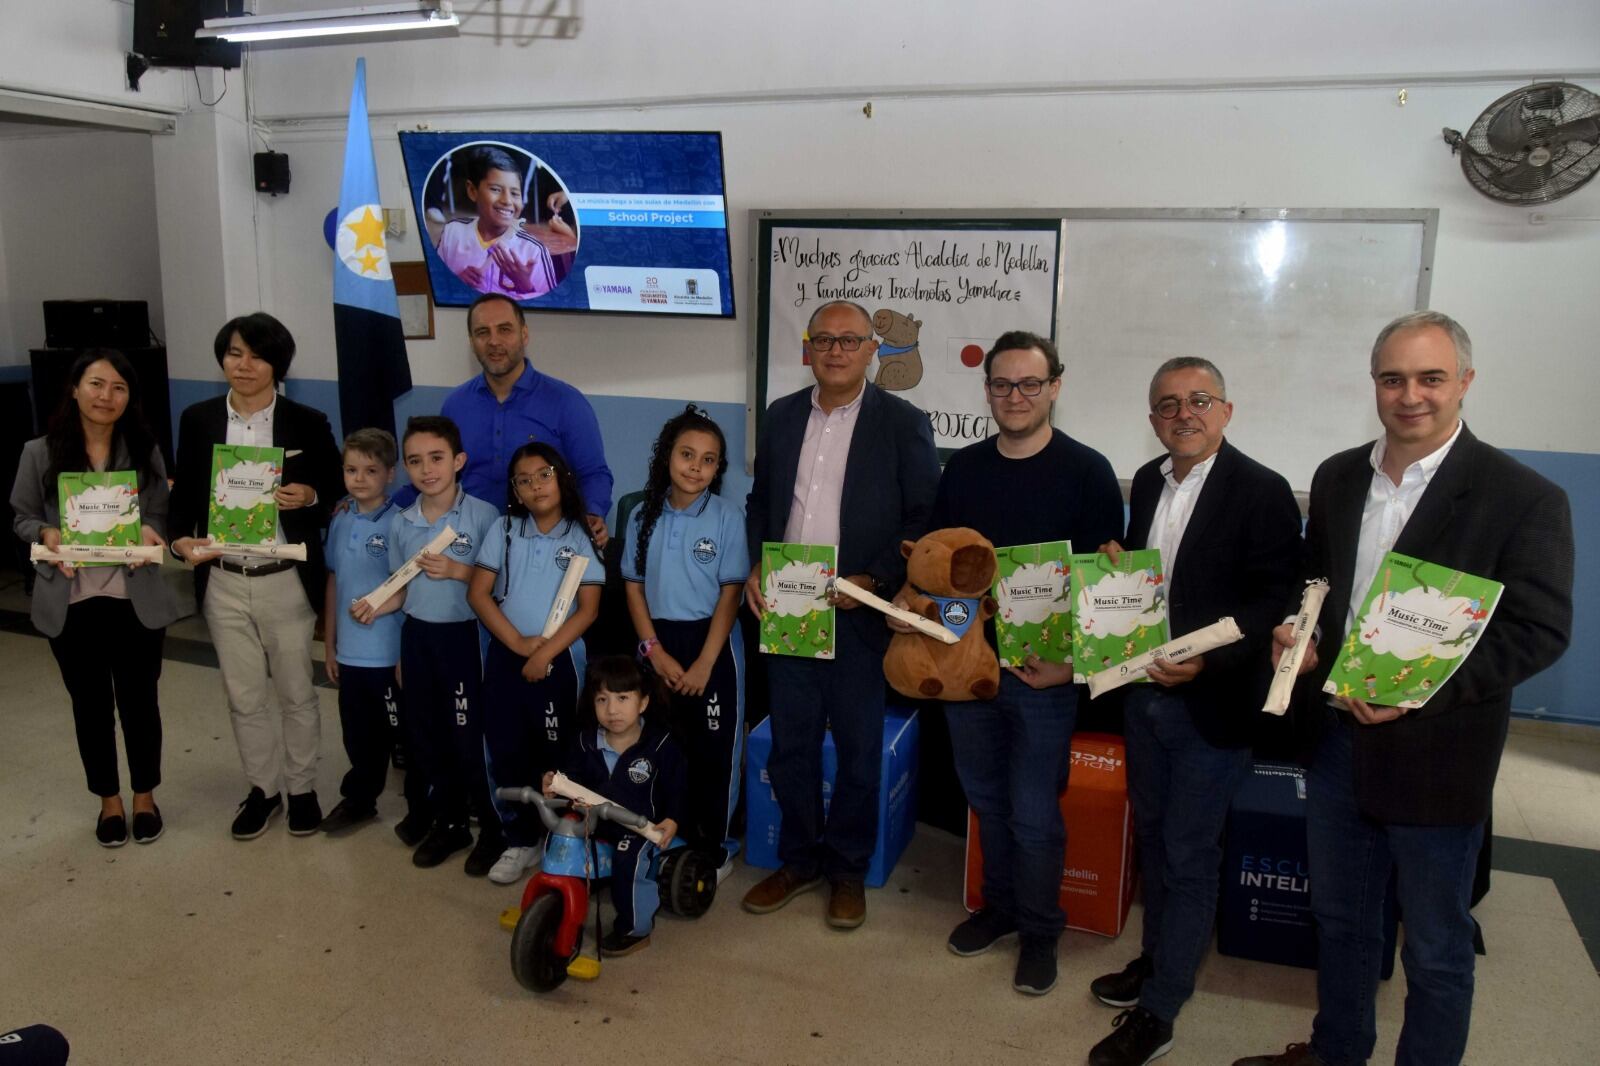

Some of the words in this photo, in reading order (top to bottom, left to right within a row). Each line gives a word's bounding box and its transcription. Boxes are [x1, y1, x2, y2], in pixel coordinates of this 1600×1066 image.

[608, 212, 648, 222] School
[651, 212, 694, 225] Project
[779, 236, 841, 270] Muchas
[846, 249, 900, 282] gracias
[976, 242, 991, 269] de
[645, 276, 658, 285] 20
[602, 285, 632, 294] YAMAHA
[794, 282, 812, 307] y
[887, 277, 952, 303] Incolmotos
[956, 275, 1014, 305] Yamaha
[924, 411, 992, 440] ROJECT
[227, 478, 247, 486] Music
[249, 479, 265, 487] Time
[79, 503, 100, 511] Music
[777, 582, 797, 590] Music
[800, 583, 817, 591] Time
[1010, 588, 1032, 596] Music
[1034, 586, 1053, 594] Time
[1093, 597, 1119, 606] Music
[1121, 596, 1143, 604] Time
[1388, 607, 1420, 624] Music
[1422, 617, 1449, 632] Time
[1240, 870, 1309, 893] INTELI
